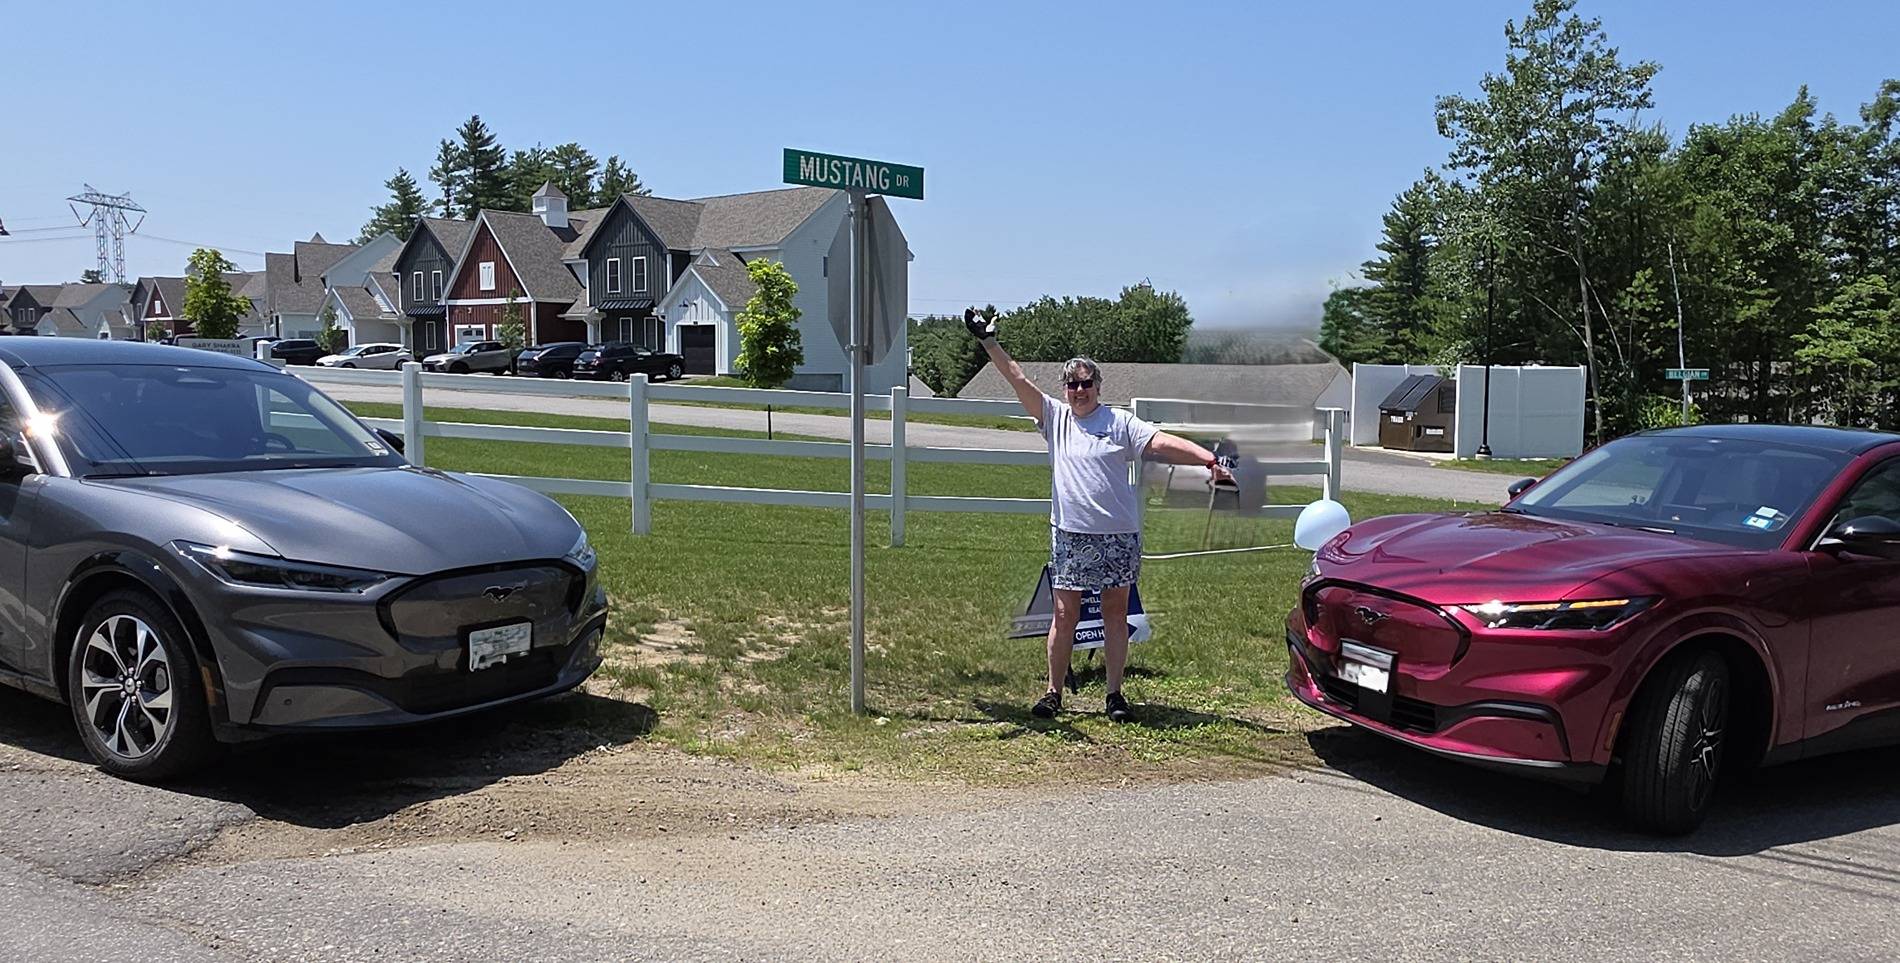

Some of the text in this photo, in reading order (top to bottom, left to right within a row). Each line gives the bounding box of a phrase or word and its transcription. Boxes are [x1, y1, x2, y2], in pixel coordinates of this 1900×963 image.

[799, 155, 909, 190] MUSTANG DR
[1080, 596, 1101, 605] DWELL
[1075, 630, 1097, 641] OPEN
